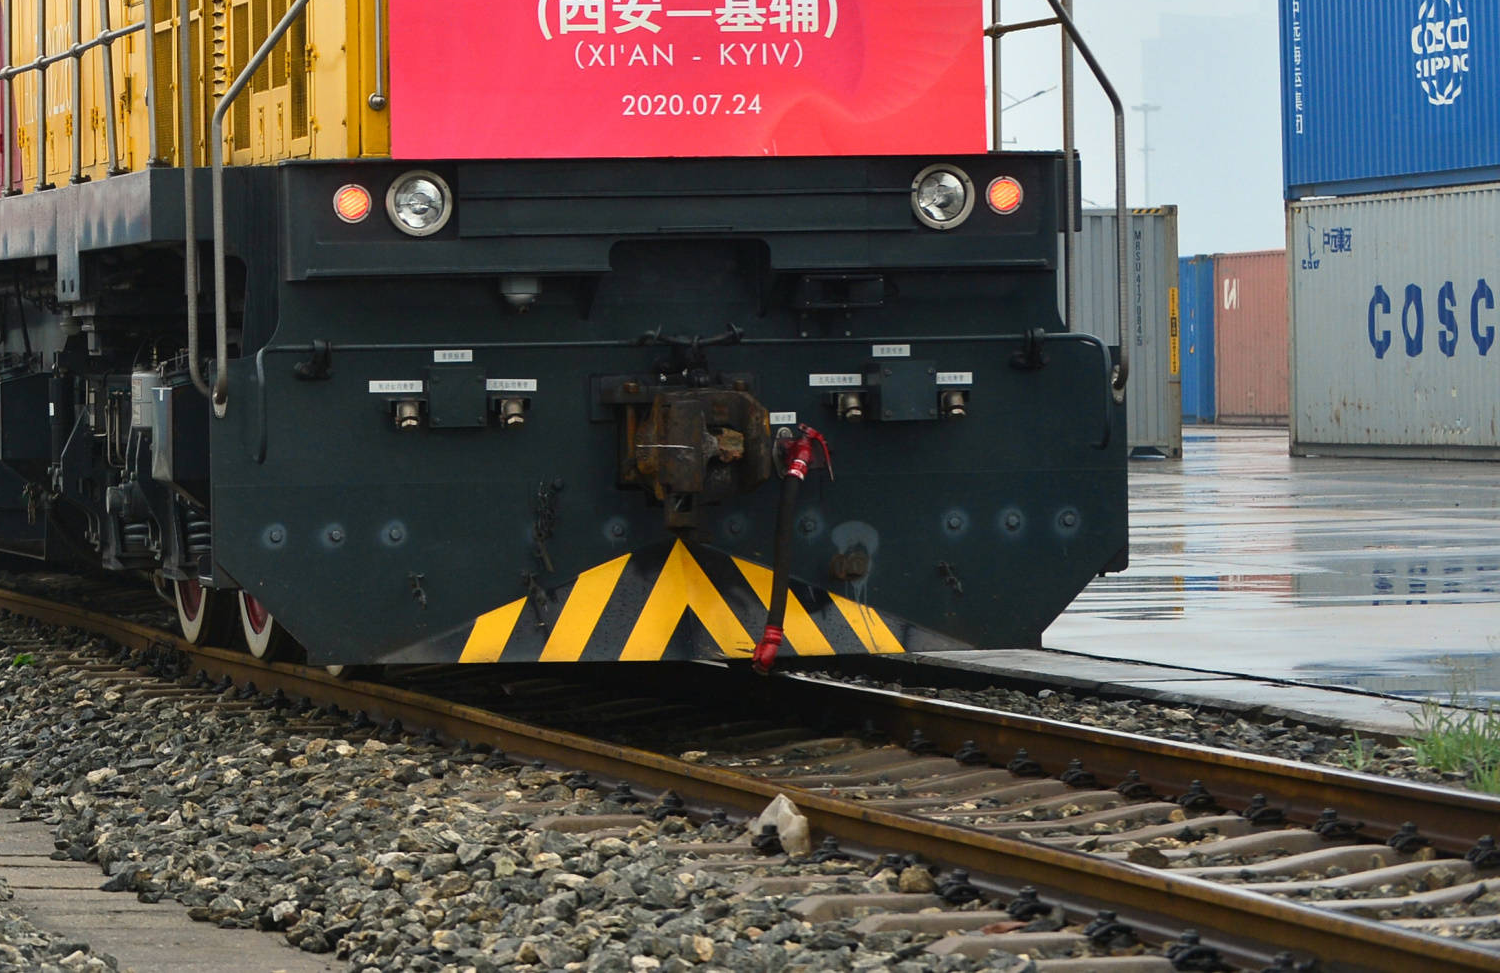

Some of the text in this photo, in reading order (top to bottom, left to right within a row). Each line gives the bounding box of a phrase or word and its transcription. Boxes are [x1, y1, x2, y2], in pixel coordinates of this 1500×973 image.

[1412, 17, 1470, 55] COSCO
[575, 40, 674, 69] (XI'AN
[719, 40, 803, 68] KYIV)
[621, 94, 762, 116] 2020.07.24
